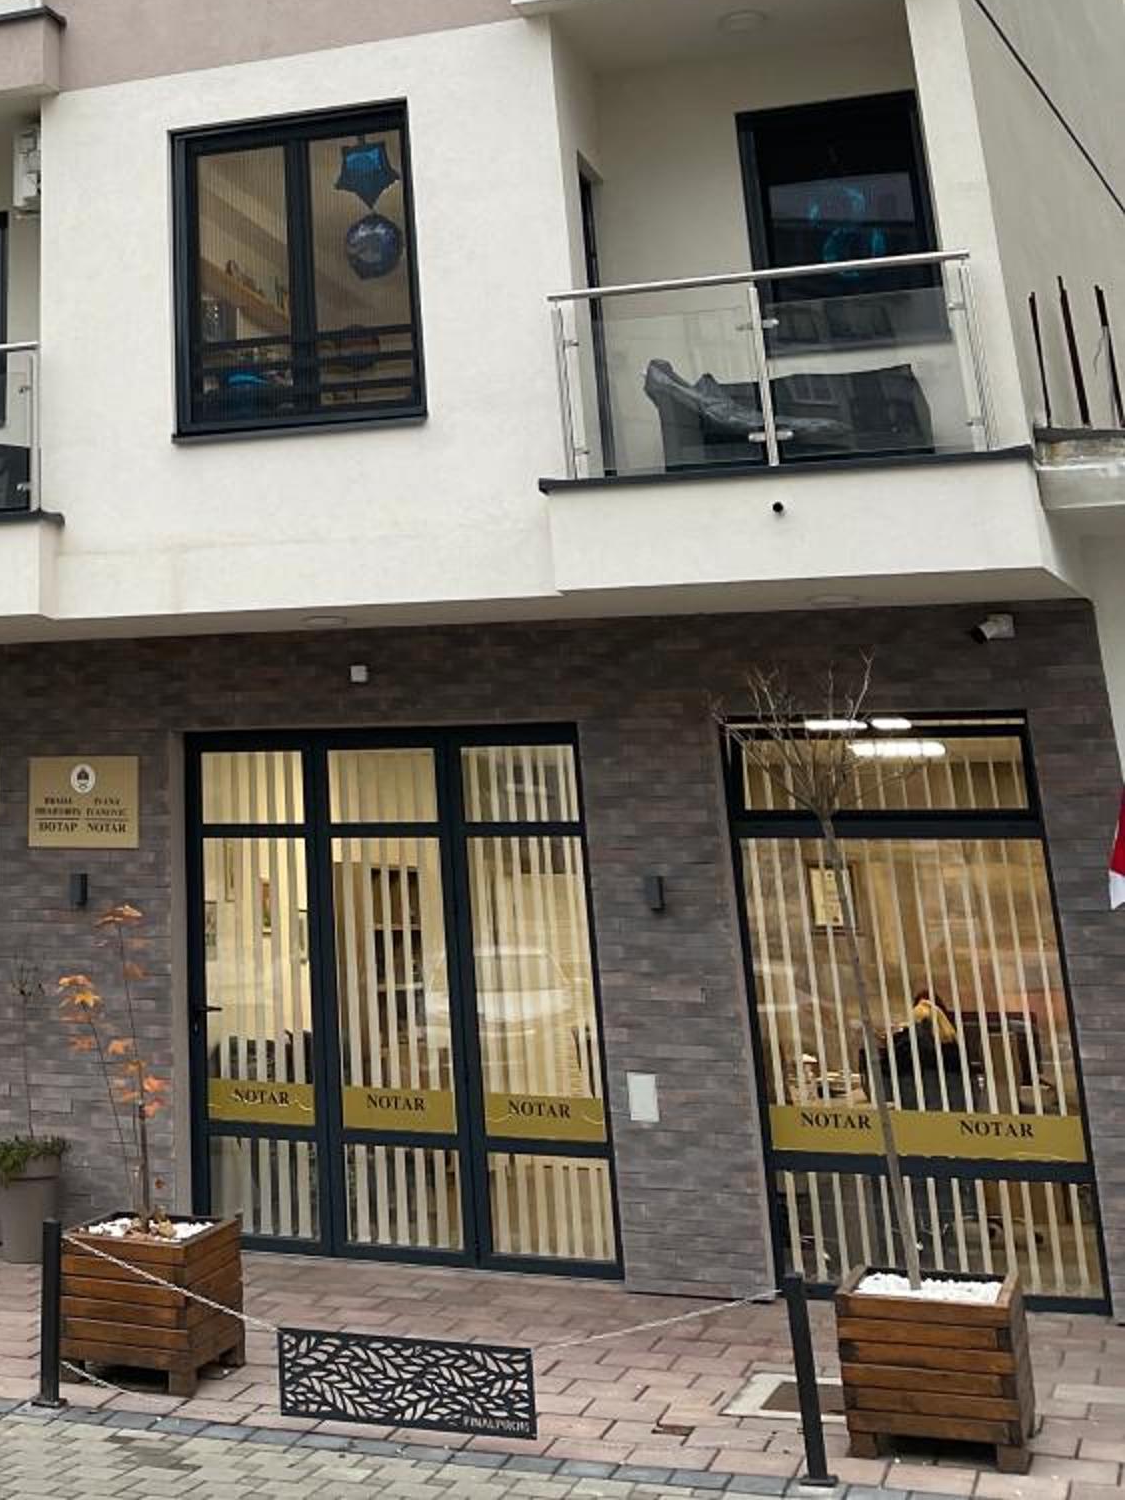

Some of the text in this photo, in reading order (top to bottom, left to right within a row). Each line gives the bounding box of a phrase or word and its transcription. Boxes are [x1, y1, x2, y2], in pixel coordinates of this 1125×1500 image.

[87, 822, 127, 834] NOTAR
[233, 1087, 290, 1106] NOTAR
[366, 1093, 427, 1112] NOTAR
[507, 1099, 571, 1120] NOTAR
[800, 1111, 873, 1131] NOTAR
[959, 1119, 1035, 1139] NOTAR
